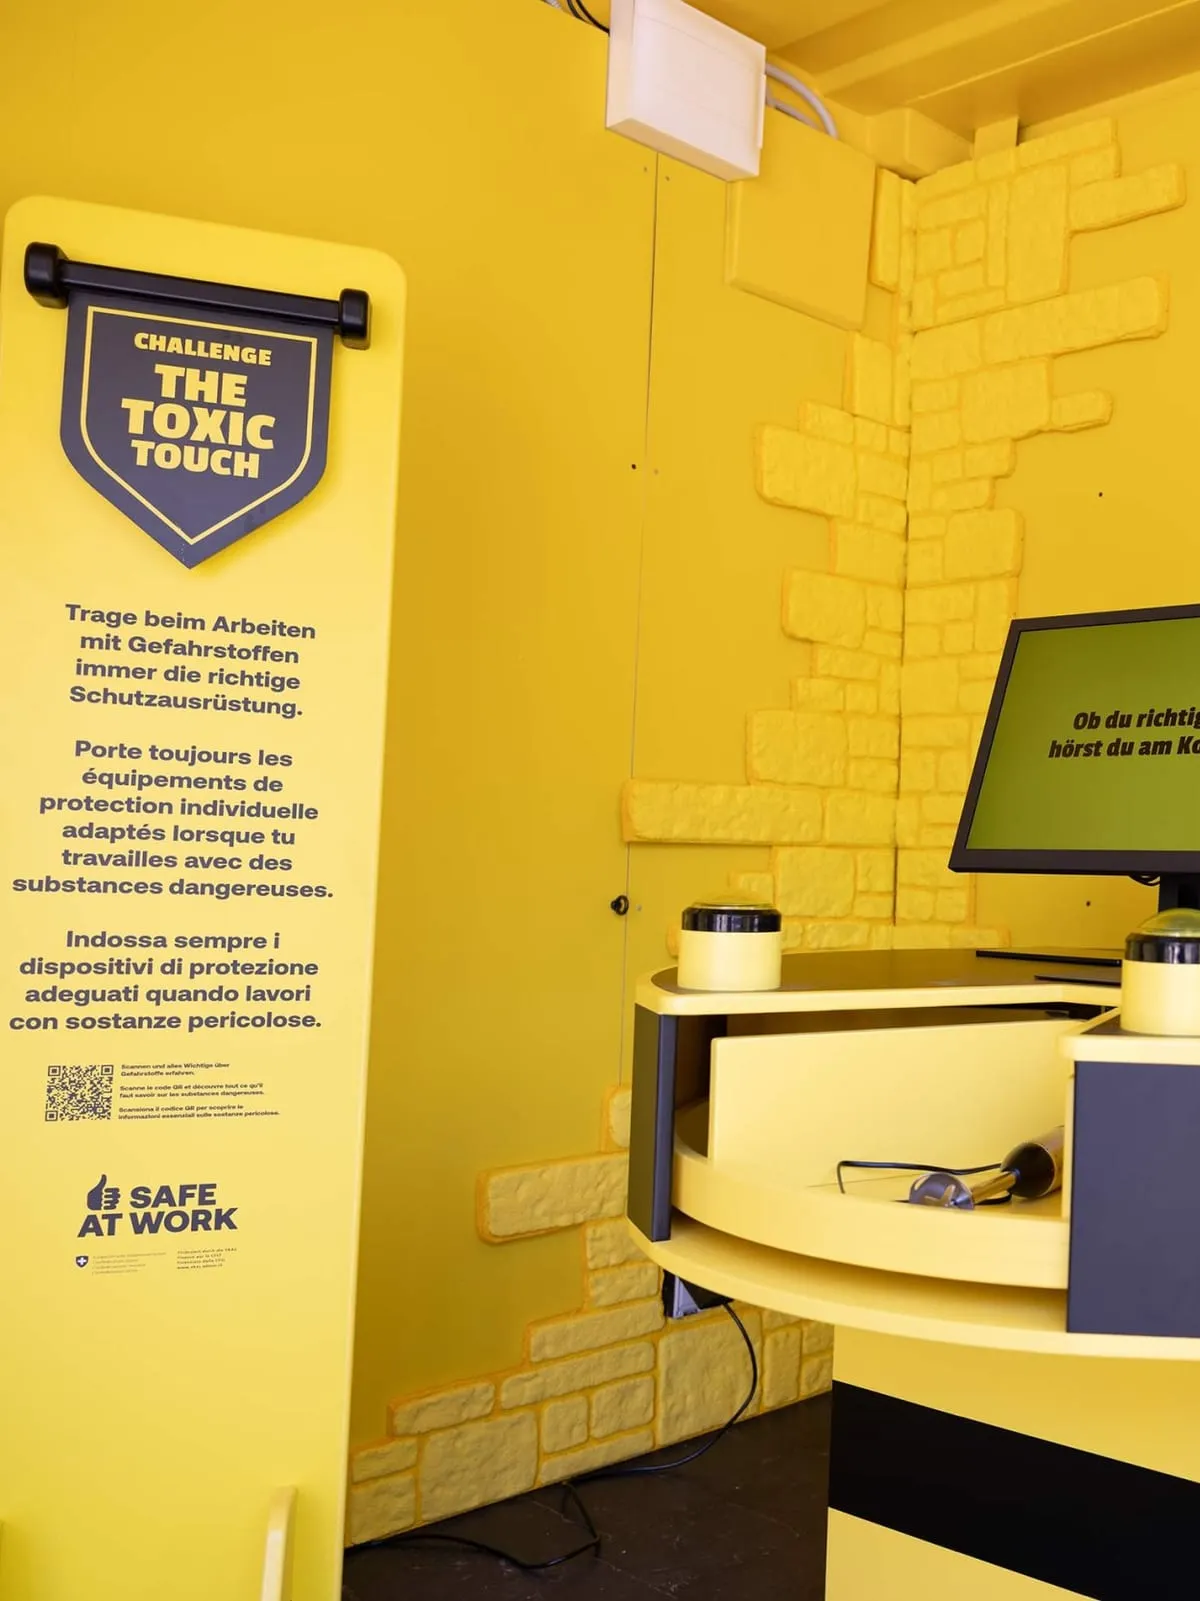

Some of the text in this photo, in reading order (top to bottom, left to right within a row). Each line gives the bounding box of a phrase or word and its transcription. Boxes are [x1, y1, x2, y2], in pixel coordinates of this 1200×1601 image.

[135, 332, 272, 366] CHALLENGE
[154, 363, 247, 407] THE
[121, 398, 276, 450] TOXIC
[131, 440, 259, 479] TOUCH
[66, 604, 316, 639] Trage beim Arbeiten
[80, 634, 299, 664] mit Gefahrstoffen
[76, 659, 300, 692] immer die richtige
[70, 686, 303, 719] Schutzausrüstung.
[1073, 712, 1101, 730] Ob
[1105, 711, 1132, 729] du
[75, 740, 292, 767] Porte toujours les
[1048, 739, 1102, 758] hörst
[1107, 738, 1134, 756] du
[1138, 740, 1171, 755] am
[82, 768, 283, 792] équipements de
[40, 795, 318, 819] protection individuelle
[62, 822, 295, 846] adaptés lorsque tu
[62, 849, 292, 871] travailles avec des
[13, 876, 333, 900] substances dangereuses.
[66, 931, 280, 952] Indossa sempre i
[20, 958, 318, 979] dispositivi di protezione
[25, 985, 310, 1006] adeguati quando lavori
[10, 1011, 321, 1032] con sostanze pericolose.
[130, 1183, 216, 1208] SAFE
[78, 1208, 238, 1237] AT WORK
